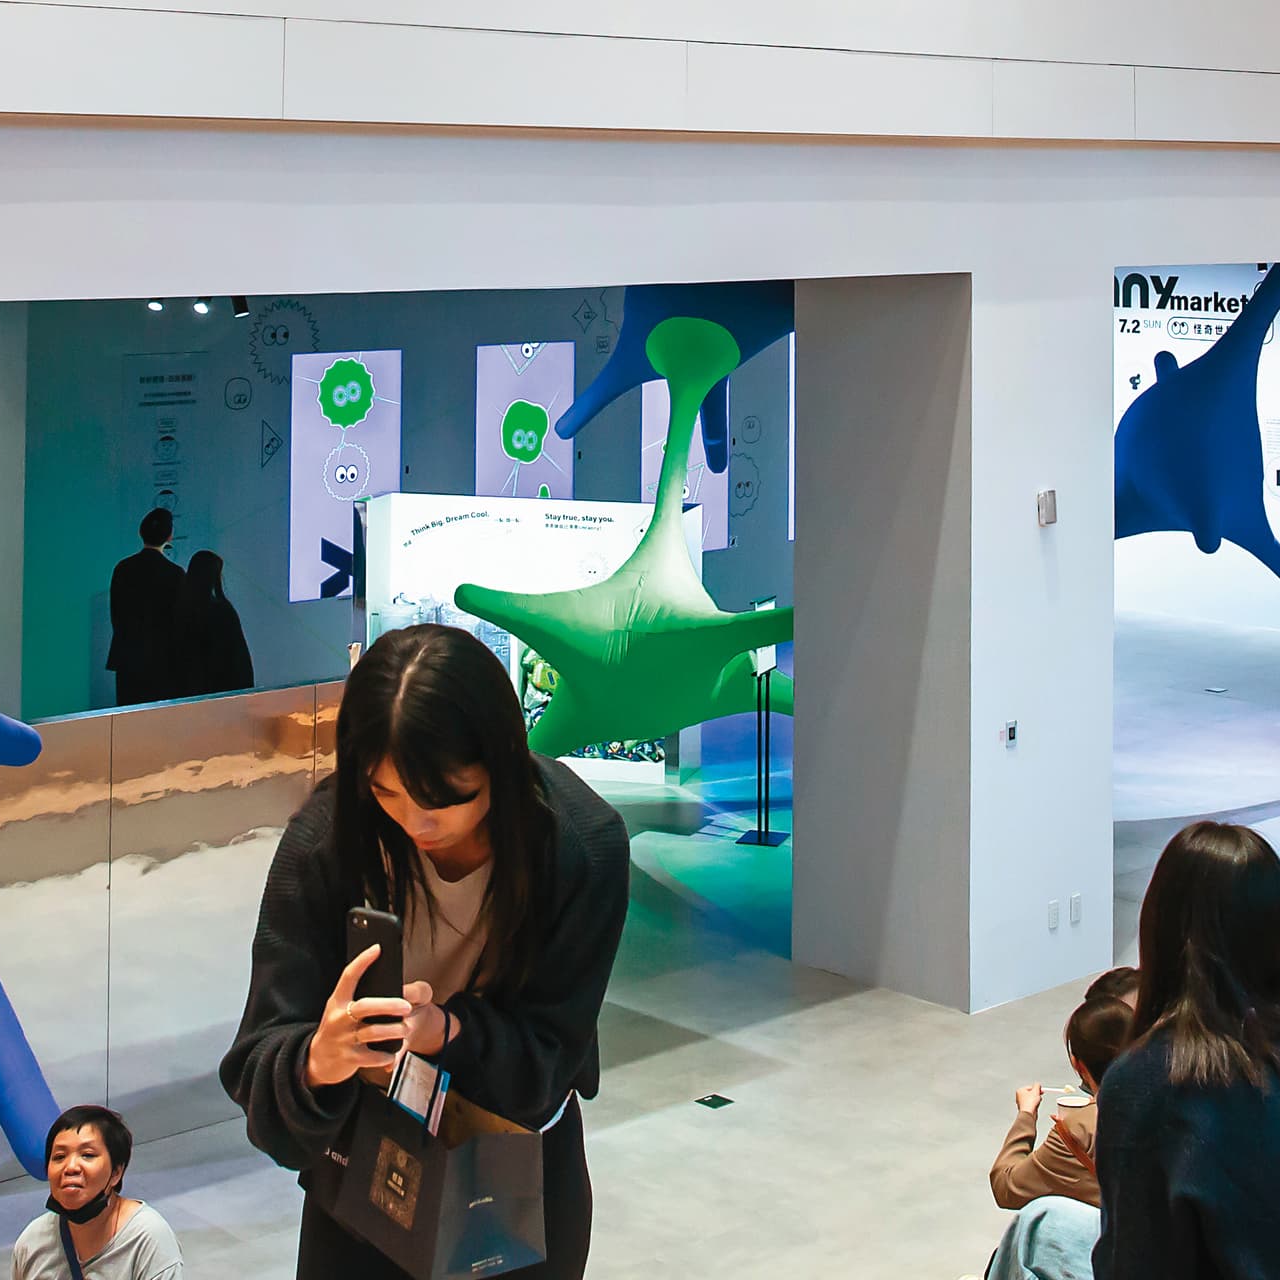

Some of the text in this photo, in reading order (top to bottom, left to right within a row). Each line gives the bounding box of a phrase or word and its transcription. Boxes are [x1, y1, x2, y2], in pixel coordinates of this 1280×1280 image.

[1170, 291, 1249, 314] market
[1119, 319, 1162, 334] 7.2 SUN
[1193, 324, 1232, 336] 怪奇世
[410, 524, 430, 536] Think
[445, 513, 470, 523] Dream
[545, 513, 561, 521] Stay
[581, 515, 597, 523] stay
